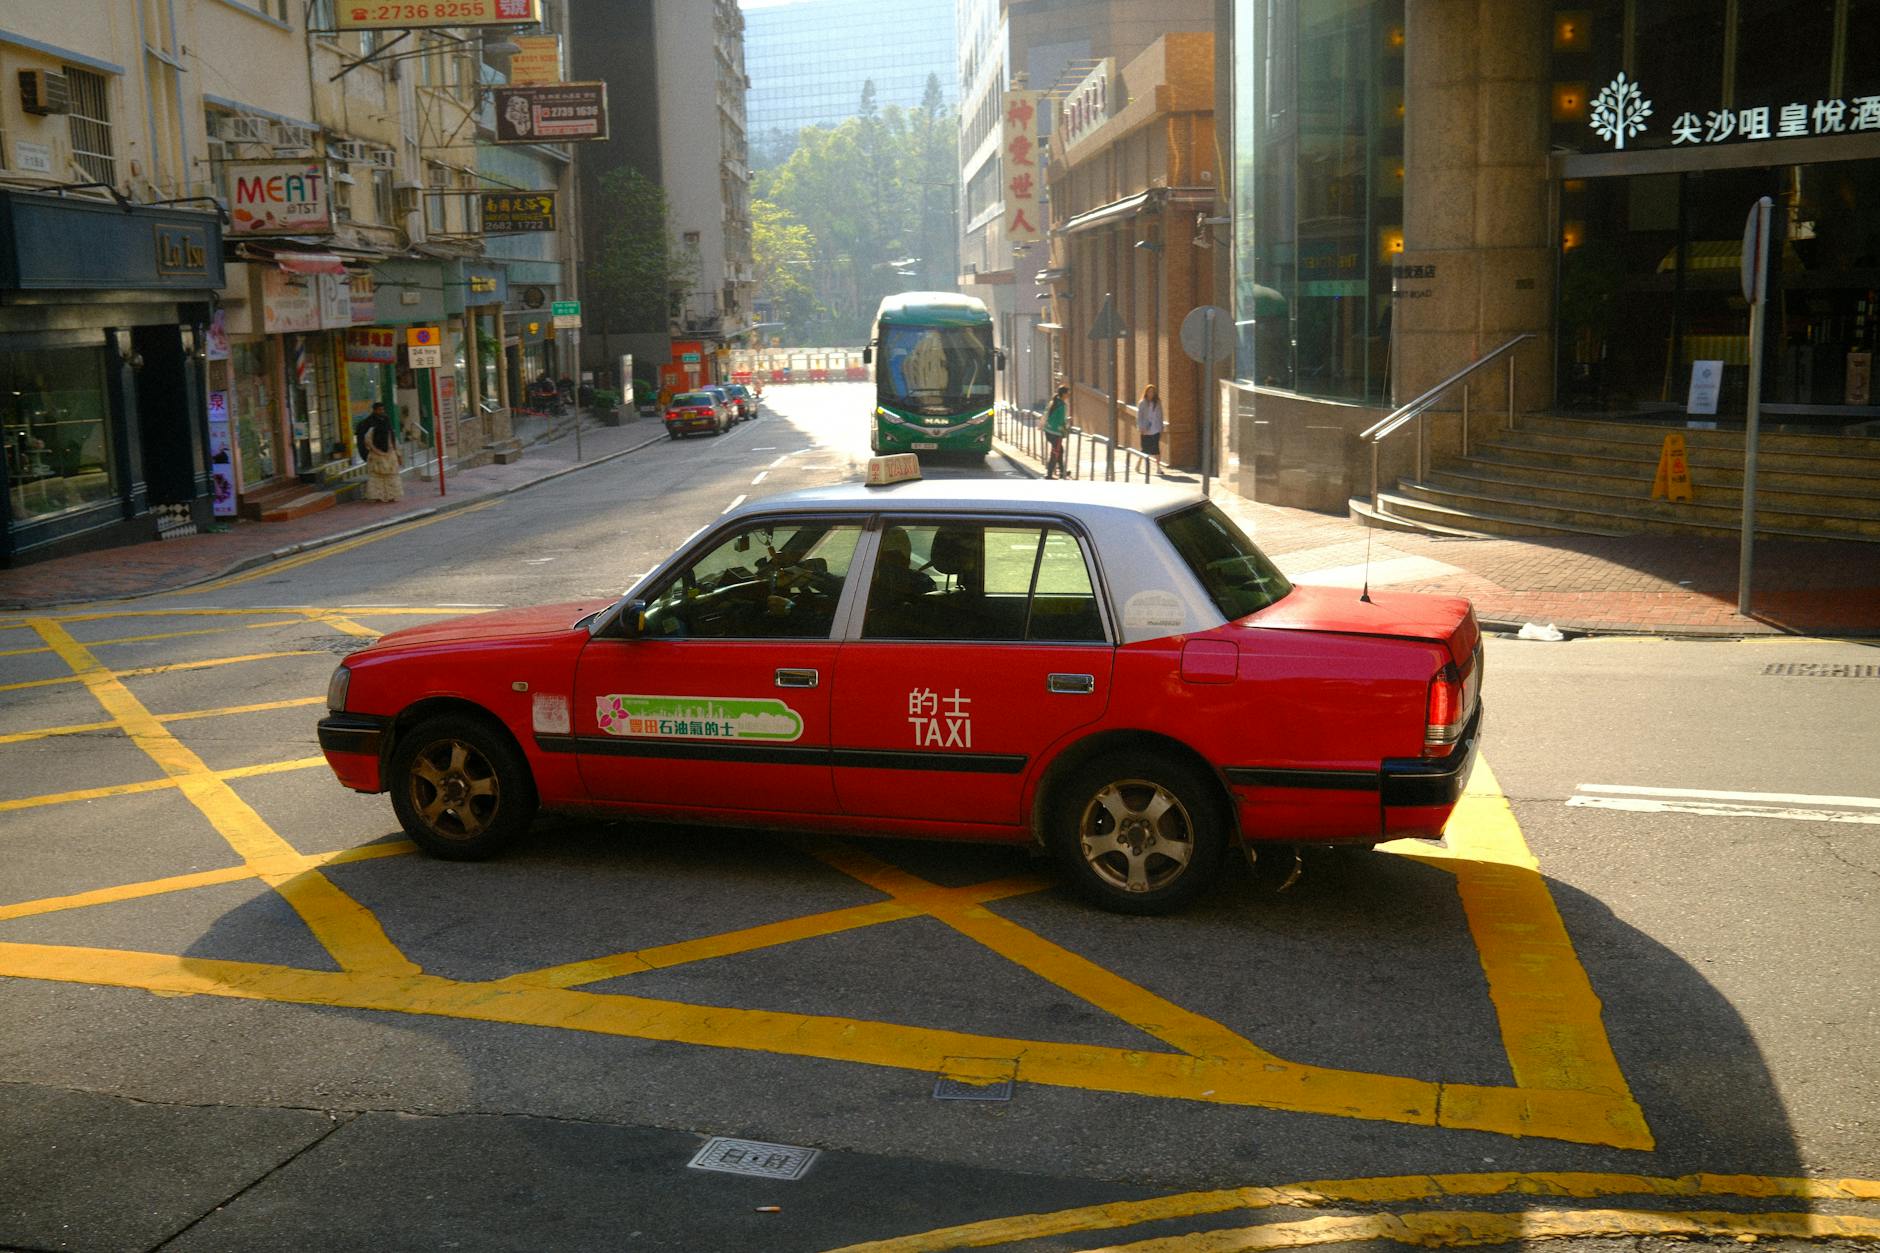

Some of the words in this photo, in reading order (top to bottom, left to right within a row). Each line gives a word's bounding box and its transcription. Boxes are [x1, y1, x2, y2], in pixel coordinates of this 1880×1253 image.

[434, 2, 485, 18] 8255
[1006, 98, 1036, 234] 神愛世人
[236, 174, 322, 204] MEAT
[287, 203, 318, 215] @TST
[887, 457, 918, 478] TAXI
[909, 687, 972, 717] 的士
[908, 717, 972, 748] TAXI
